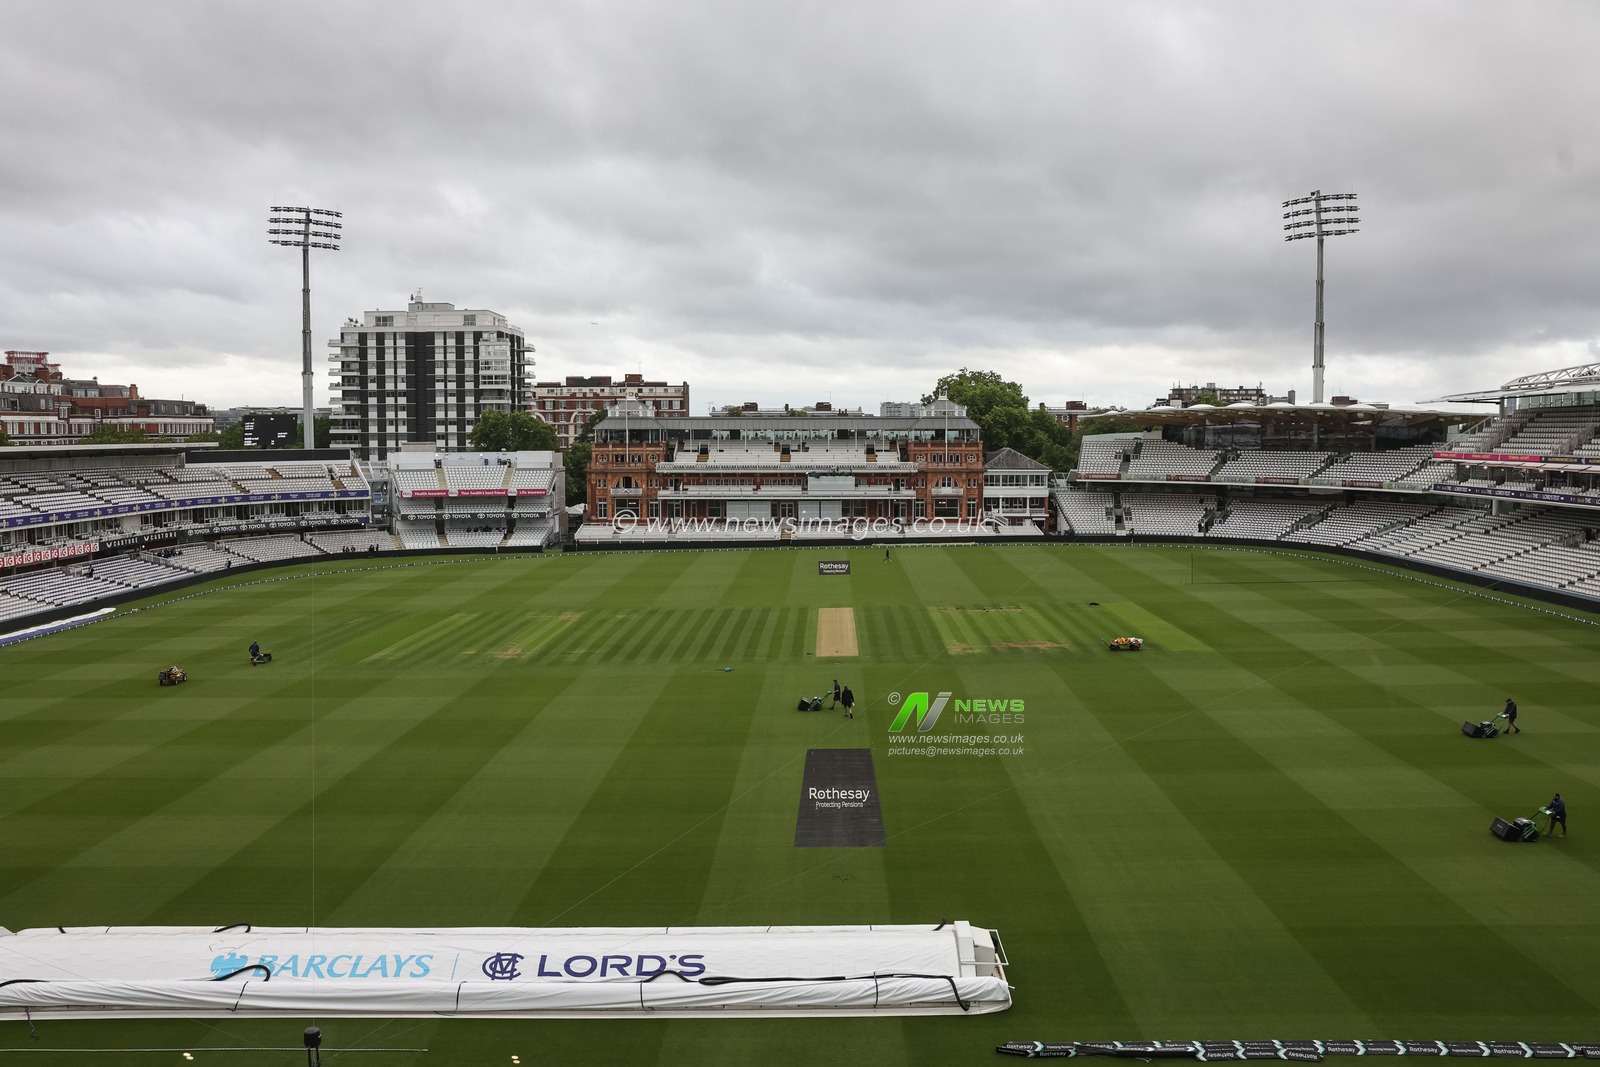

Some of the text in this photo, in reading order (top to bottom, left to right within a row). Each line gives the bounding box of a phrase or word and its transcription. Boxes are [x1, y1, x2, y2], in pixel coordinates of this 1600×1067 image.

[113, 537, 138, 546] CASTORE
[150, 532, 177, 541] CASTORE
[808, 788, 870, 801] Rothesay
[816, 801, 841, 809] Protecting
[252, 955, 434, 978] BARCLAYS
[537, 955, 706, 978] LORD'S
